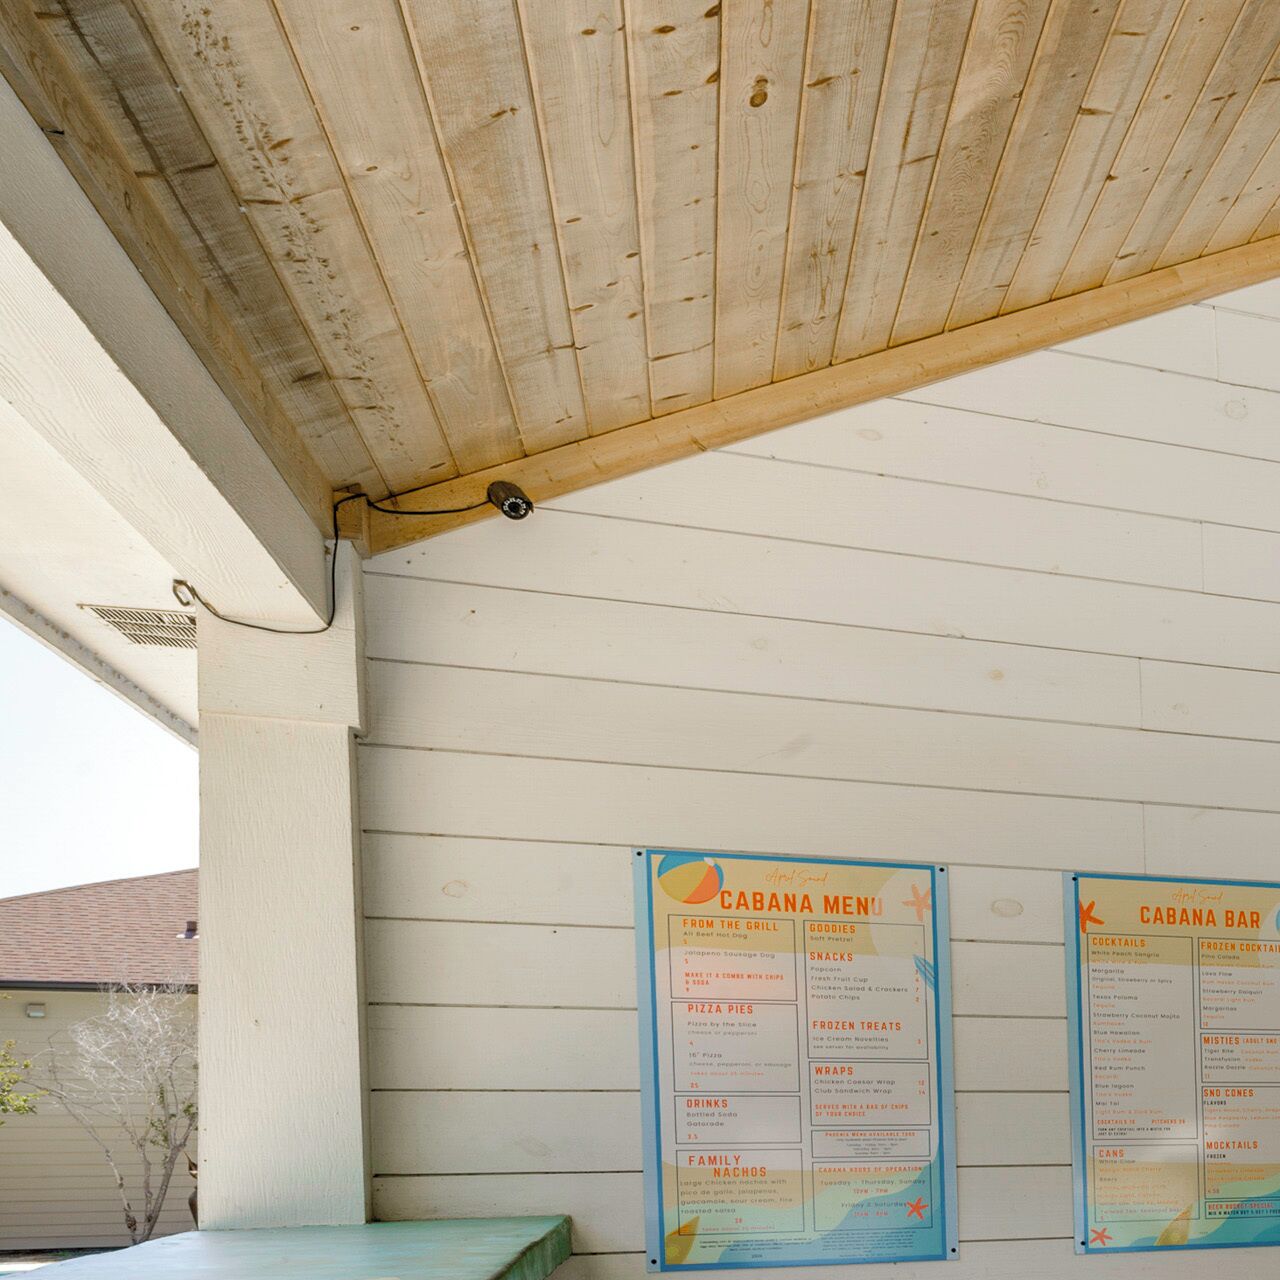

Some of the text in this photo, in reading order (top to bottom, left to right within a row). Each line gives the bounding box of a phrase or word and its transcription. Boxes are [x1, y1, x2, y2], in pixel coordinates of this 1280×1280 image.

[720, 890, 883, 916] CABANA MENU
[1140, 906, 1260, 929] CABANA BAR
[683, 919, 779, 931] FROM THE GRILL
[809, 924, 856, 933] GOODIES
[1092, 937, 1146, 947] COCKTAILS
[1201, 942, 1236, 951] FROZEN
[810, 952, 853, 961] SNACKS
[688, 1004, 753, 1014] PIZZA PIES
[812, 1020, 901, 1031] FROZEN TREATS
[1204, 1037, 1240, 1045] MISTIES
[815, 1067, 853, 1075] WRAPS
[1204, 1089, 1254, 1097] SNO CONES
[687, 1099, 728, 1108] DRINKS
[1206, 1141, 1258, 1150] MOCKTAILS
[1099, 1149, 1124, 1158] CANS
[688, 1155, 741, 1166] FAMILY
[713, 1167, 767, 1177] NACHOS
